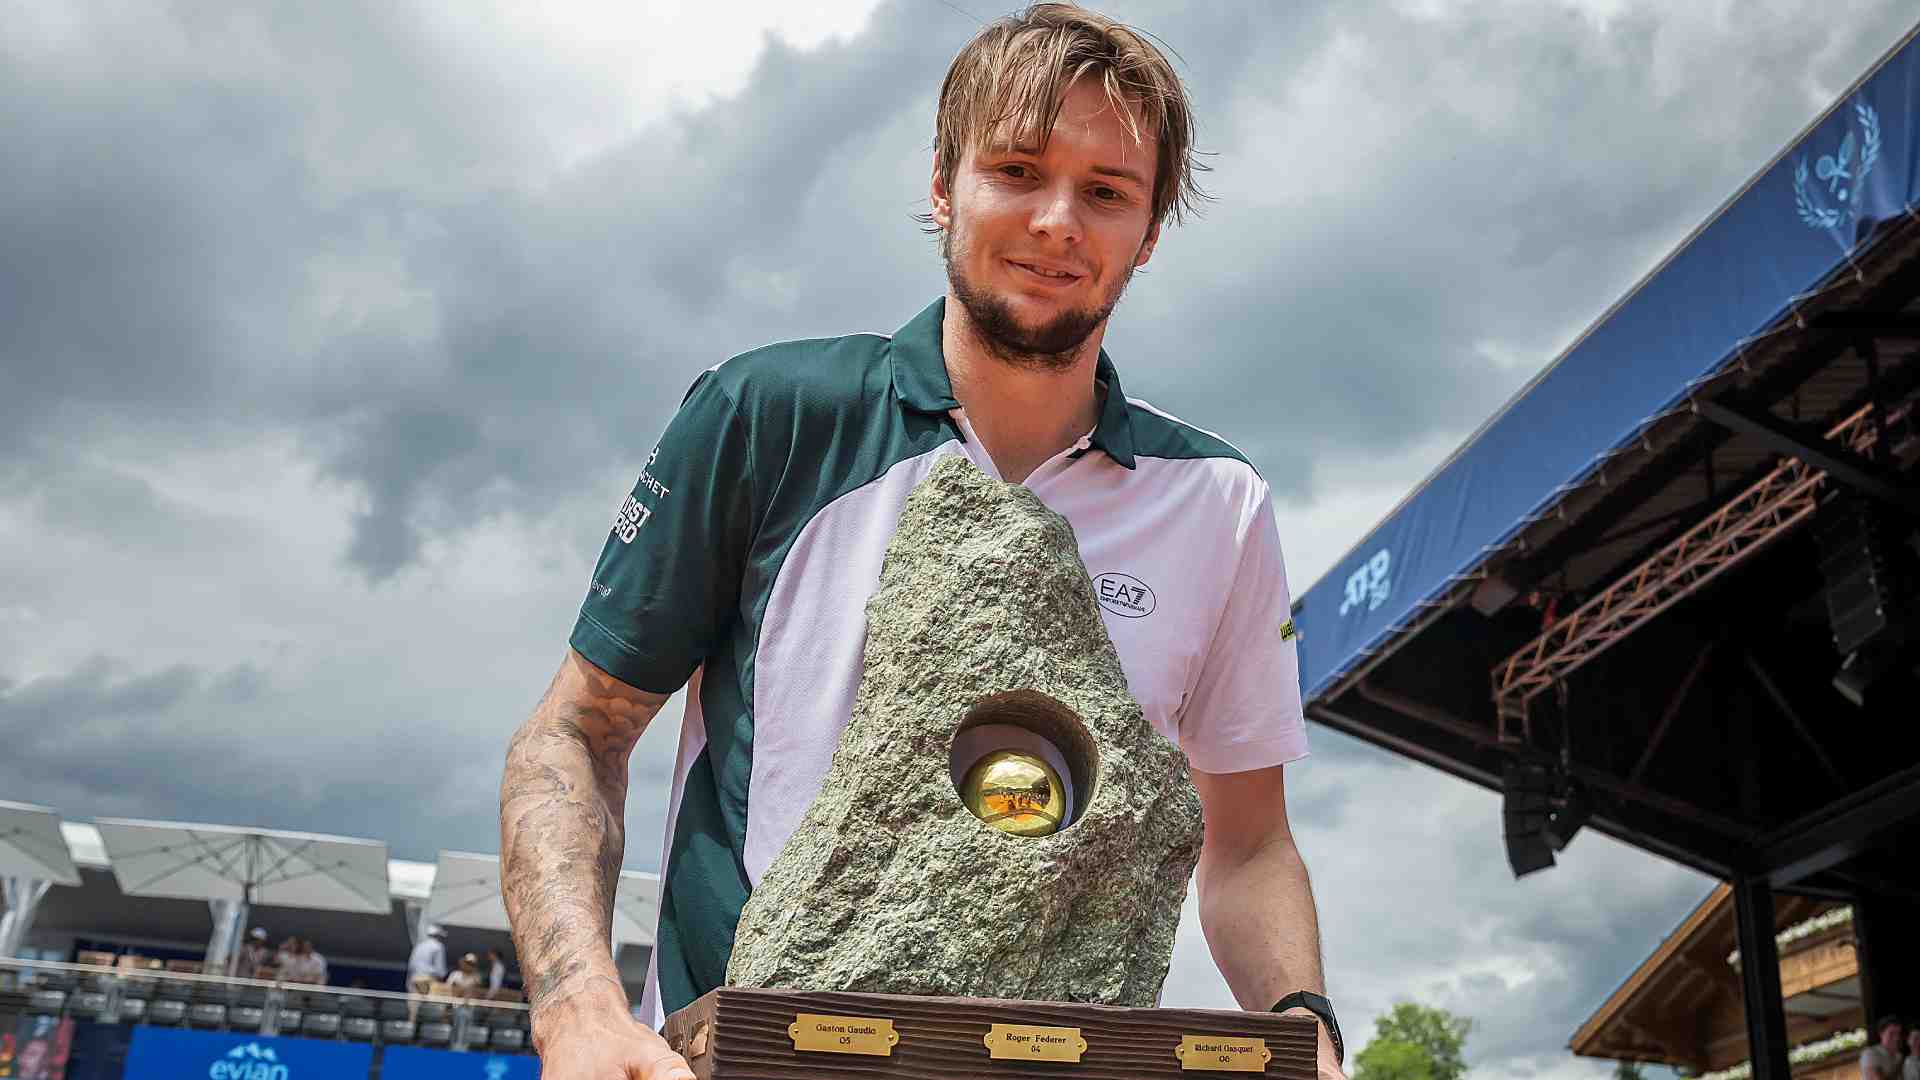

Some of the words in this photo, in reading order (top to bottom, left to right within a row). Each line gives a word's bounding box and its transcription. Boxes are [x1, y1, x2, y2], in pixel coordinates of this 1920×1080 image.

[1340, 549, 1390, 614] ATP
[1100, 578, 1147, 606] EA7
[815, 1023, 845, 1033] Gaston
[847, 1025, 877, 1035] Gaudio
[1006, 1033, 1031, 1043] Roger
[1035, 1034, 1066, 1044] Federer
[1194, 1043, 1222, 1052] Richard
[209, 1058, 289, 1080] evian
